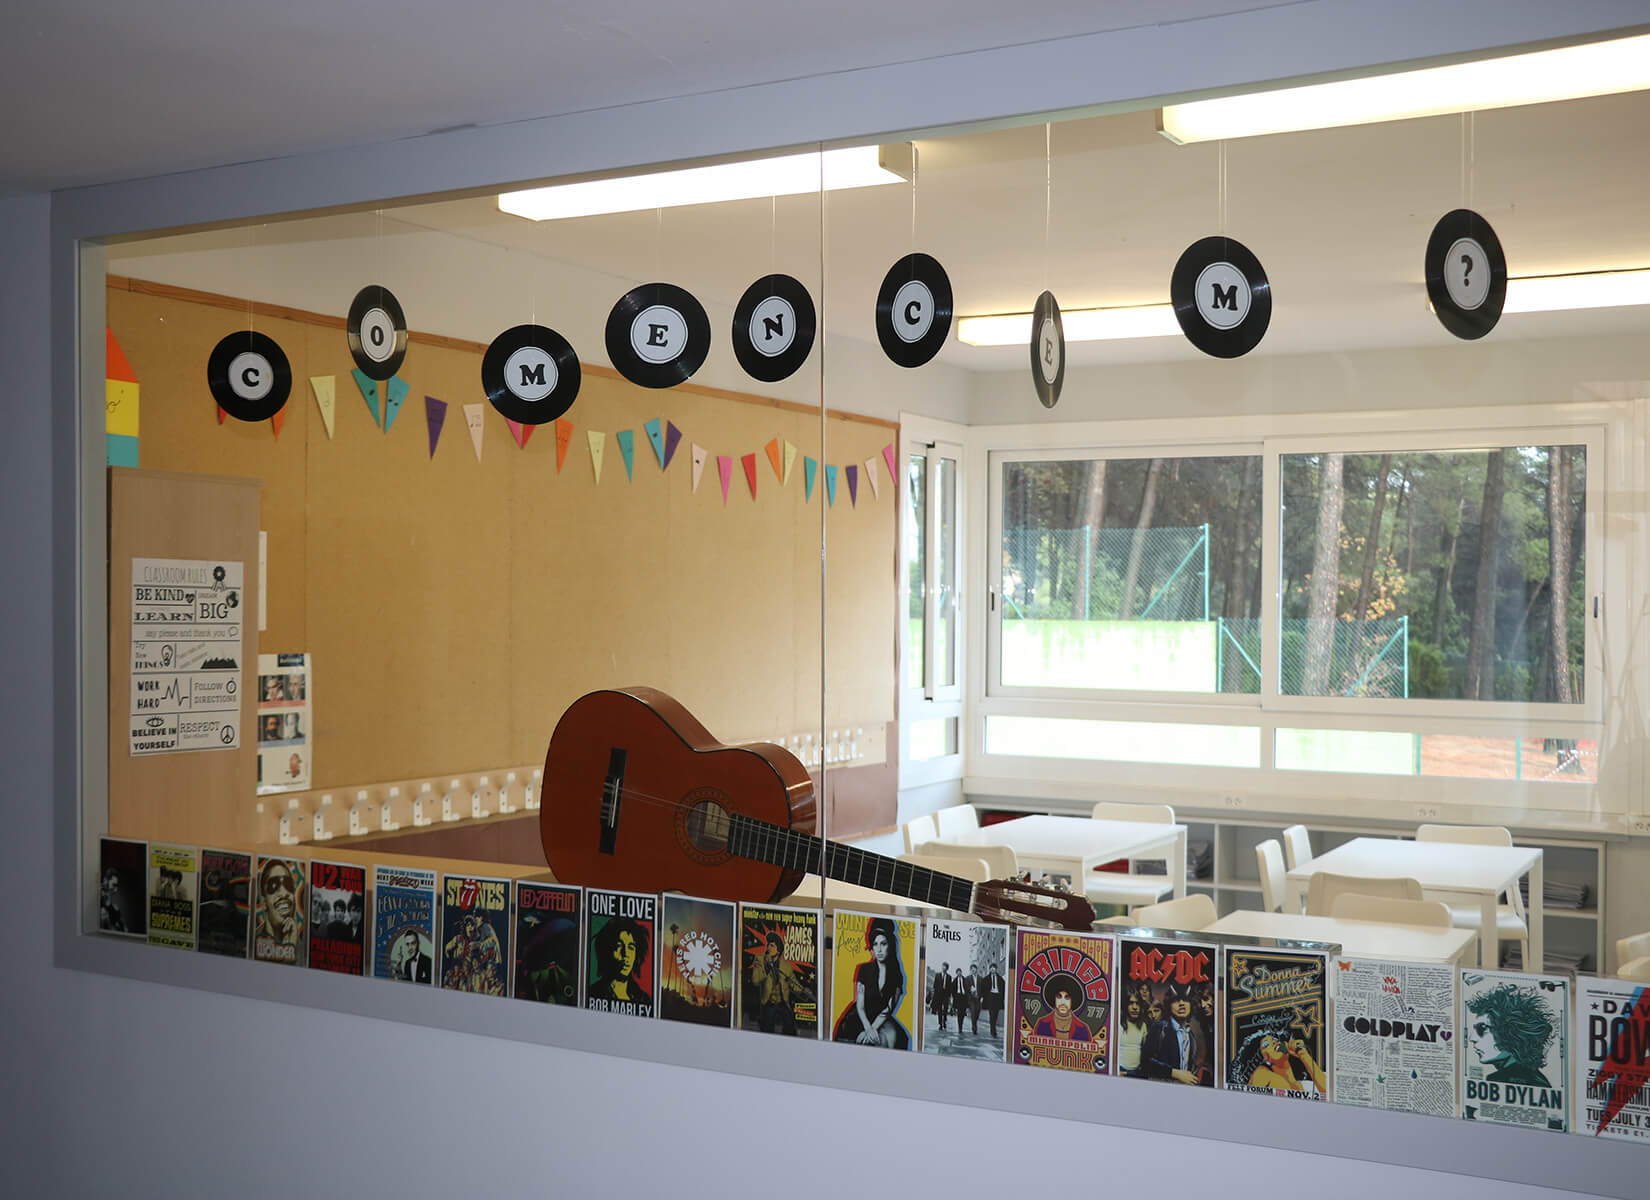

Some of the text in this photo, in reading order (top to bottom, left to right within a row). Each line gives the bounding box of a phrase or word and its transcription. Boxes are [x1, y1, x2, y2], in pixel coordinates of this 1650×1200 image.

[242, 255, 1473, 387] C O M E N C E M ?
[136, 588, 184, 601] BE KIND
[135, 612, 195, 621] LEARN
[200, 603, 228, 619] BIG
[137, 681, 160, 691] WORK
[194, 682, 224, 691] FOLLOW
[137, 698, 160, 709] HARD
[194, 695, 237, 704] DIRECTIONS
[132, 728, 166, 737] BELIEVE
[180, 721, 221, 733] RESPECT
[133, 740, 176, 751] YOURSELF
[312, 862, 338, 890] U2
[446, 879, 505, 911] STNES
[591, 894, 653, 919] ONE LOVE
[680, 931, 697, 947] RED
[700, 931, 721, 951] HOT
[784, 925, 813, 946] JAMES
[932, 924, 962, 942] BEATLES
[783, 943, 815, 963] BROWN
[1129, 946, 1210, 984] AC/DC
[1021, 947, 1110, 1002] PRINCE
[1254, 965, 1306, 984] Donna
[1240, 974, 1313, 1001] Summer
[589, 997, 609, 1012] BOB
[1024, 998, 1041, 1016] 19
[1343, 1016, 1441, 1042] COLDPLAY
[1028, 1035, 1098, 1051] MINNEAPOLIS
[1032, 1048, 1094, 1070] FUNK
[1247, 1084, 1274, 1096] FORUM
[1287, 1090, 1311, 1100] NOV.
[1466, 1079, 1563, 1110] BOB DYLAN
